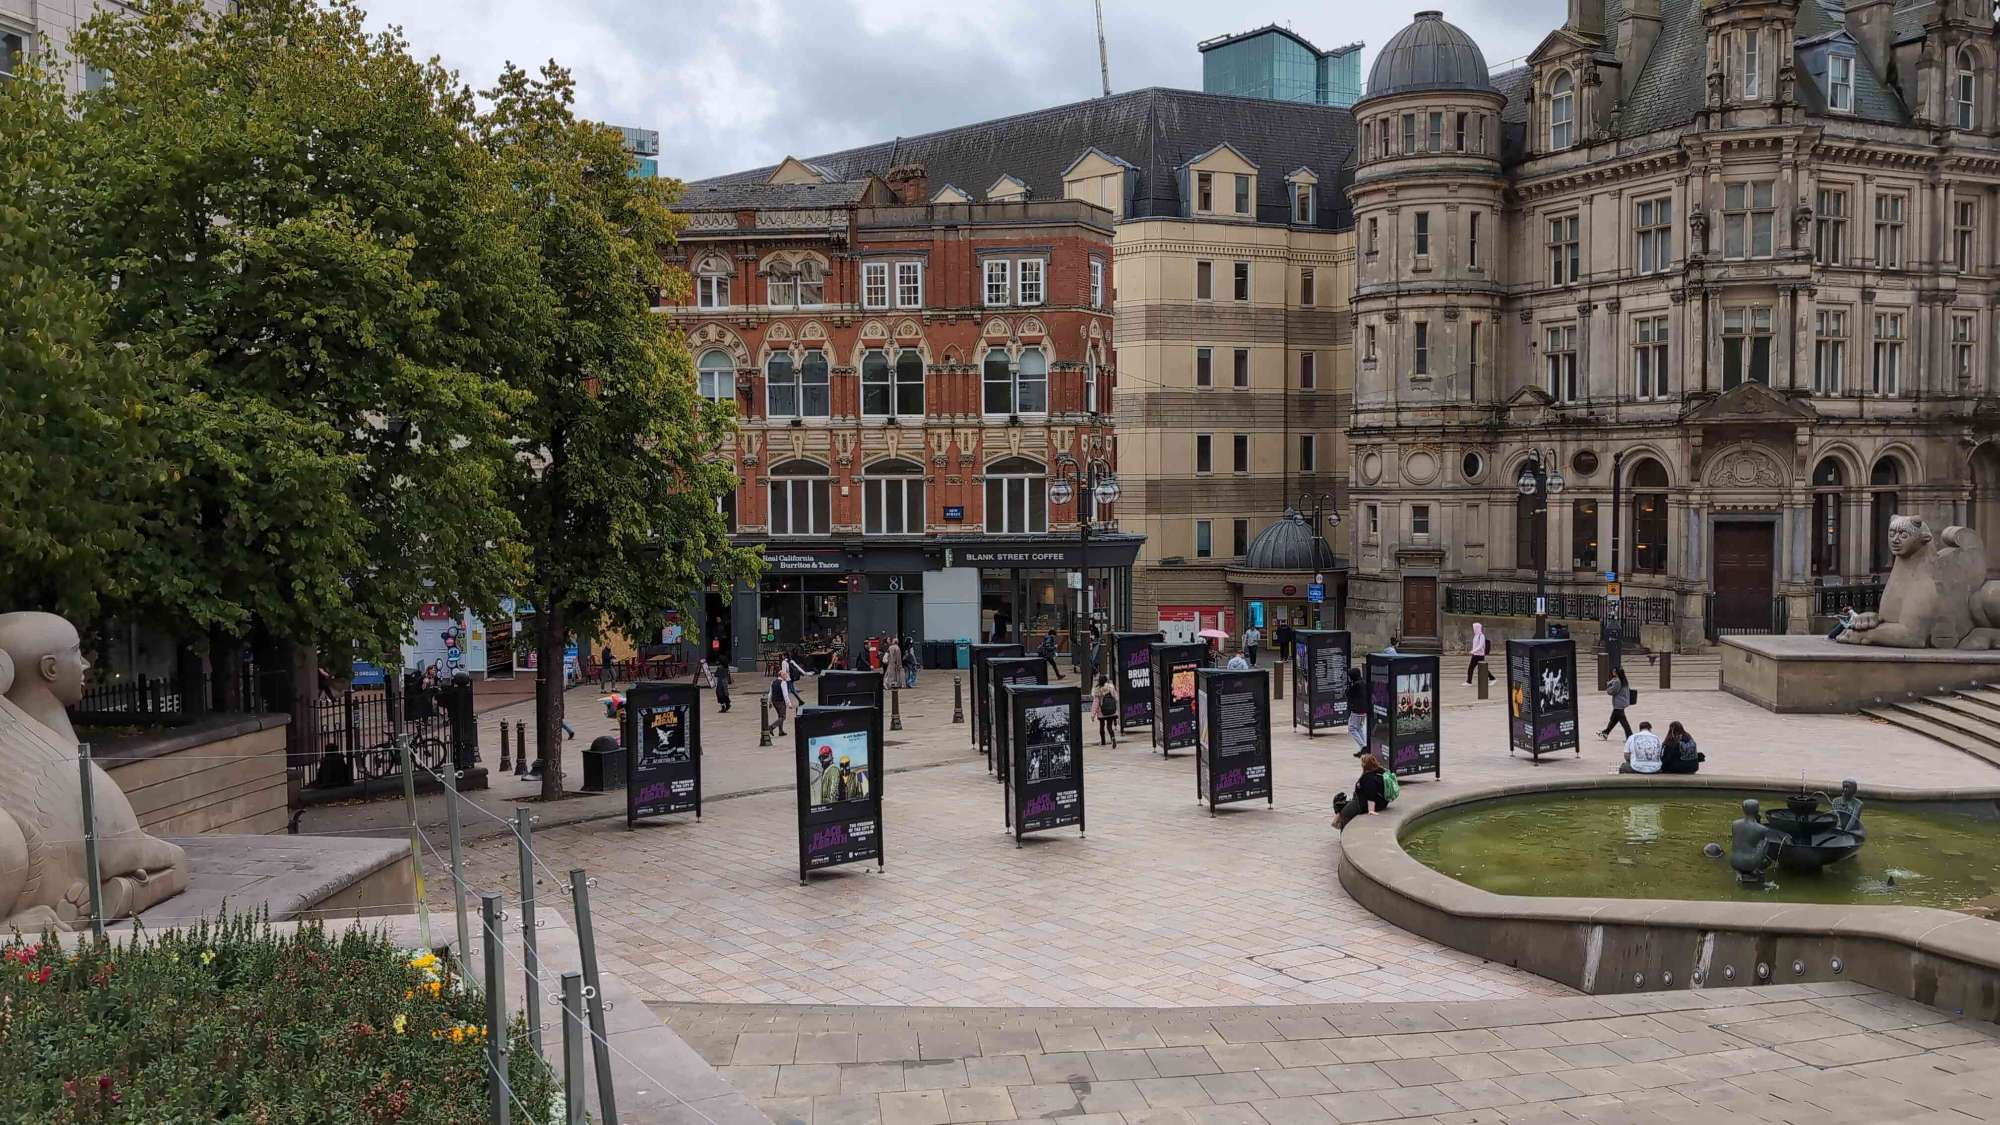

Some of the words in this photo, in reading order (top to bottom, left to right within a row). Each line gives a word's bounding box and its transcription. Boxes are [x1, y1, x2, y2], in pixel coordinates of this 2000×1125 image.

[889, 575, 904, 591] 81
[1128, 668, 1150, 680] BRUM
[1131, 678, 1150, 689] OWN
